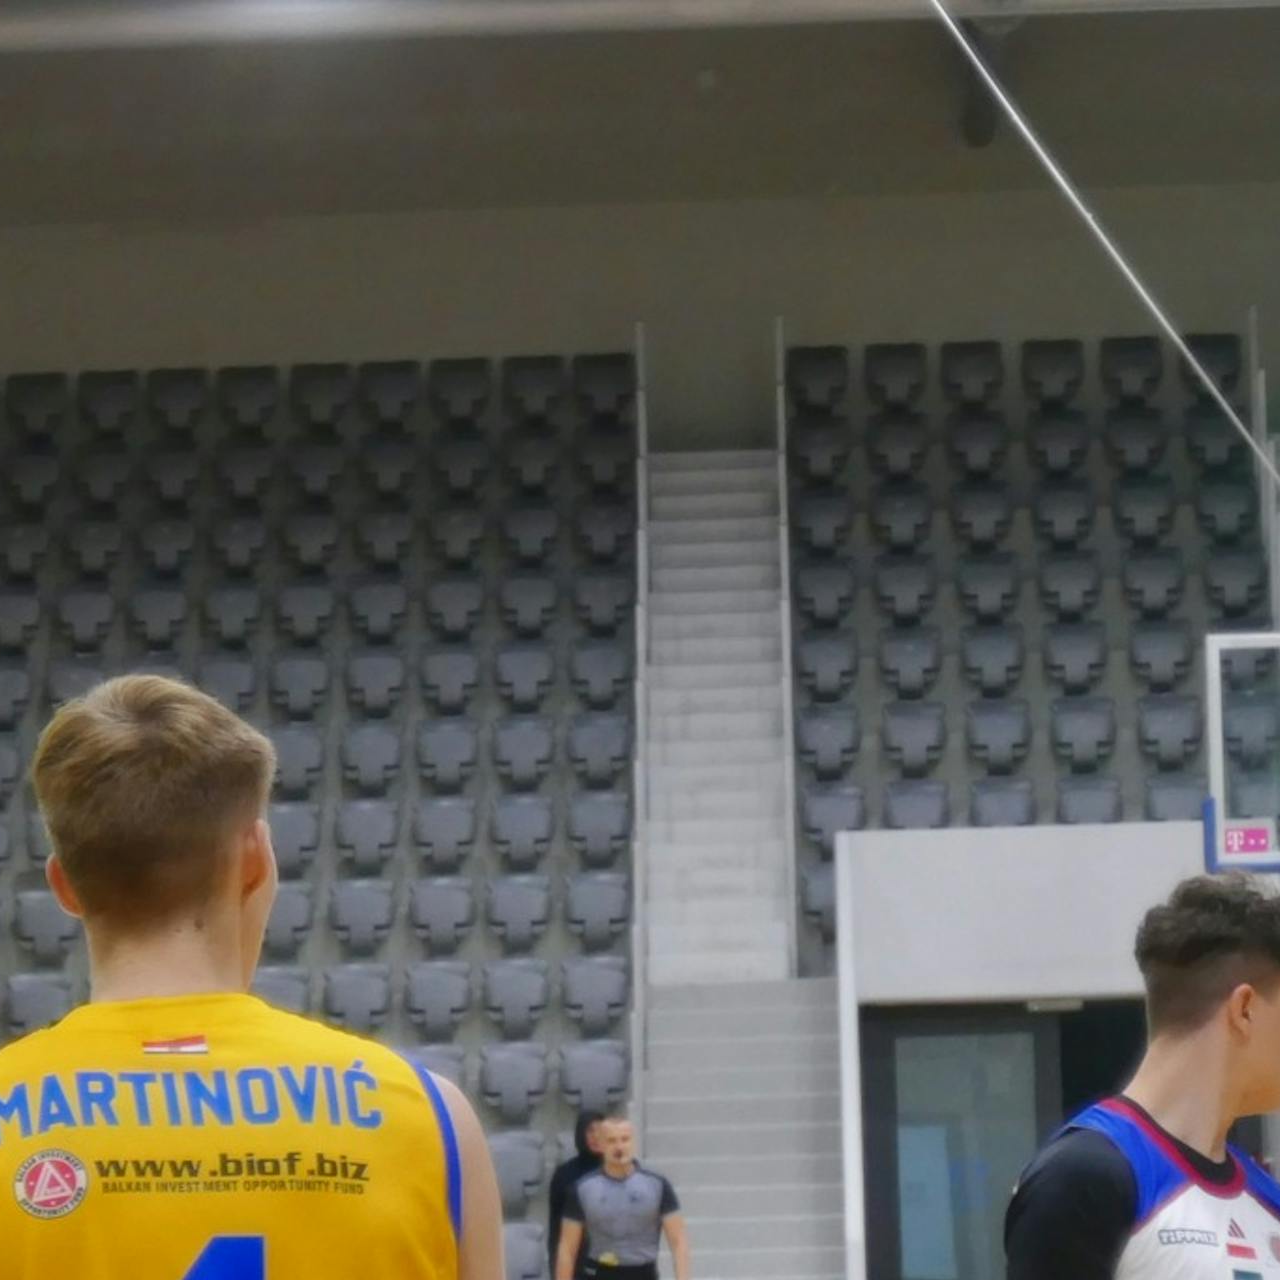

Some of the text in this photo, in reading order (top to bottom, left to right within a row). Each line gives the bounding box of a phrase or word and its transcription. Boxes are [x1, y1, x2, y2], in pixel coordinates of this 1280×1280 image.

[102, 1179, 364, 1195] BALKAN INVESTMENT OPPORTUNITY FUND
